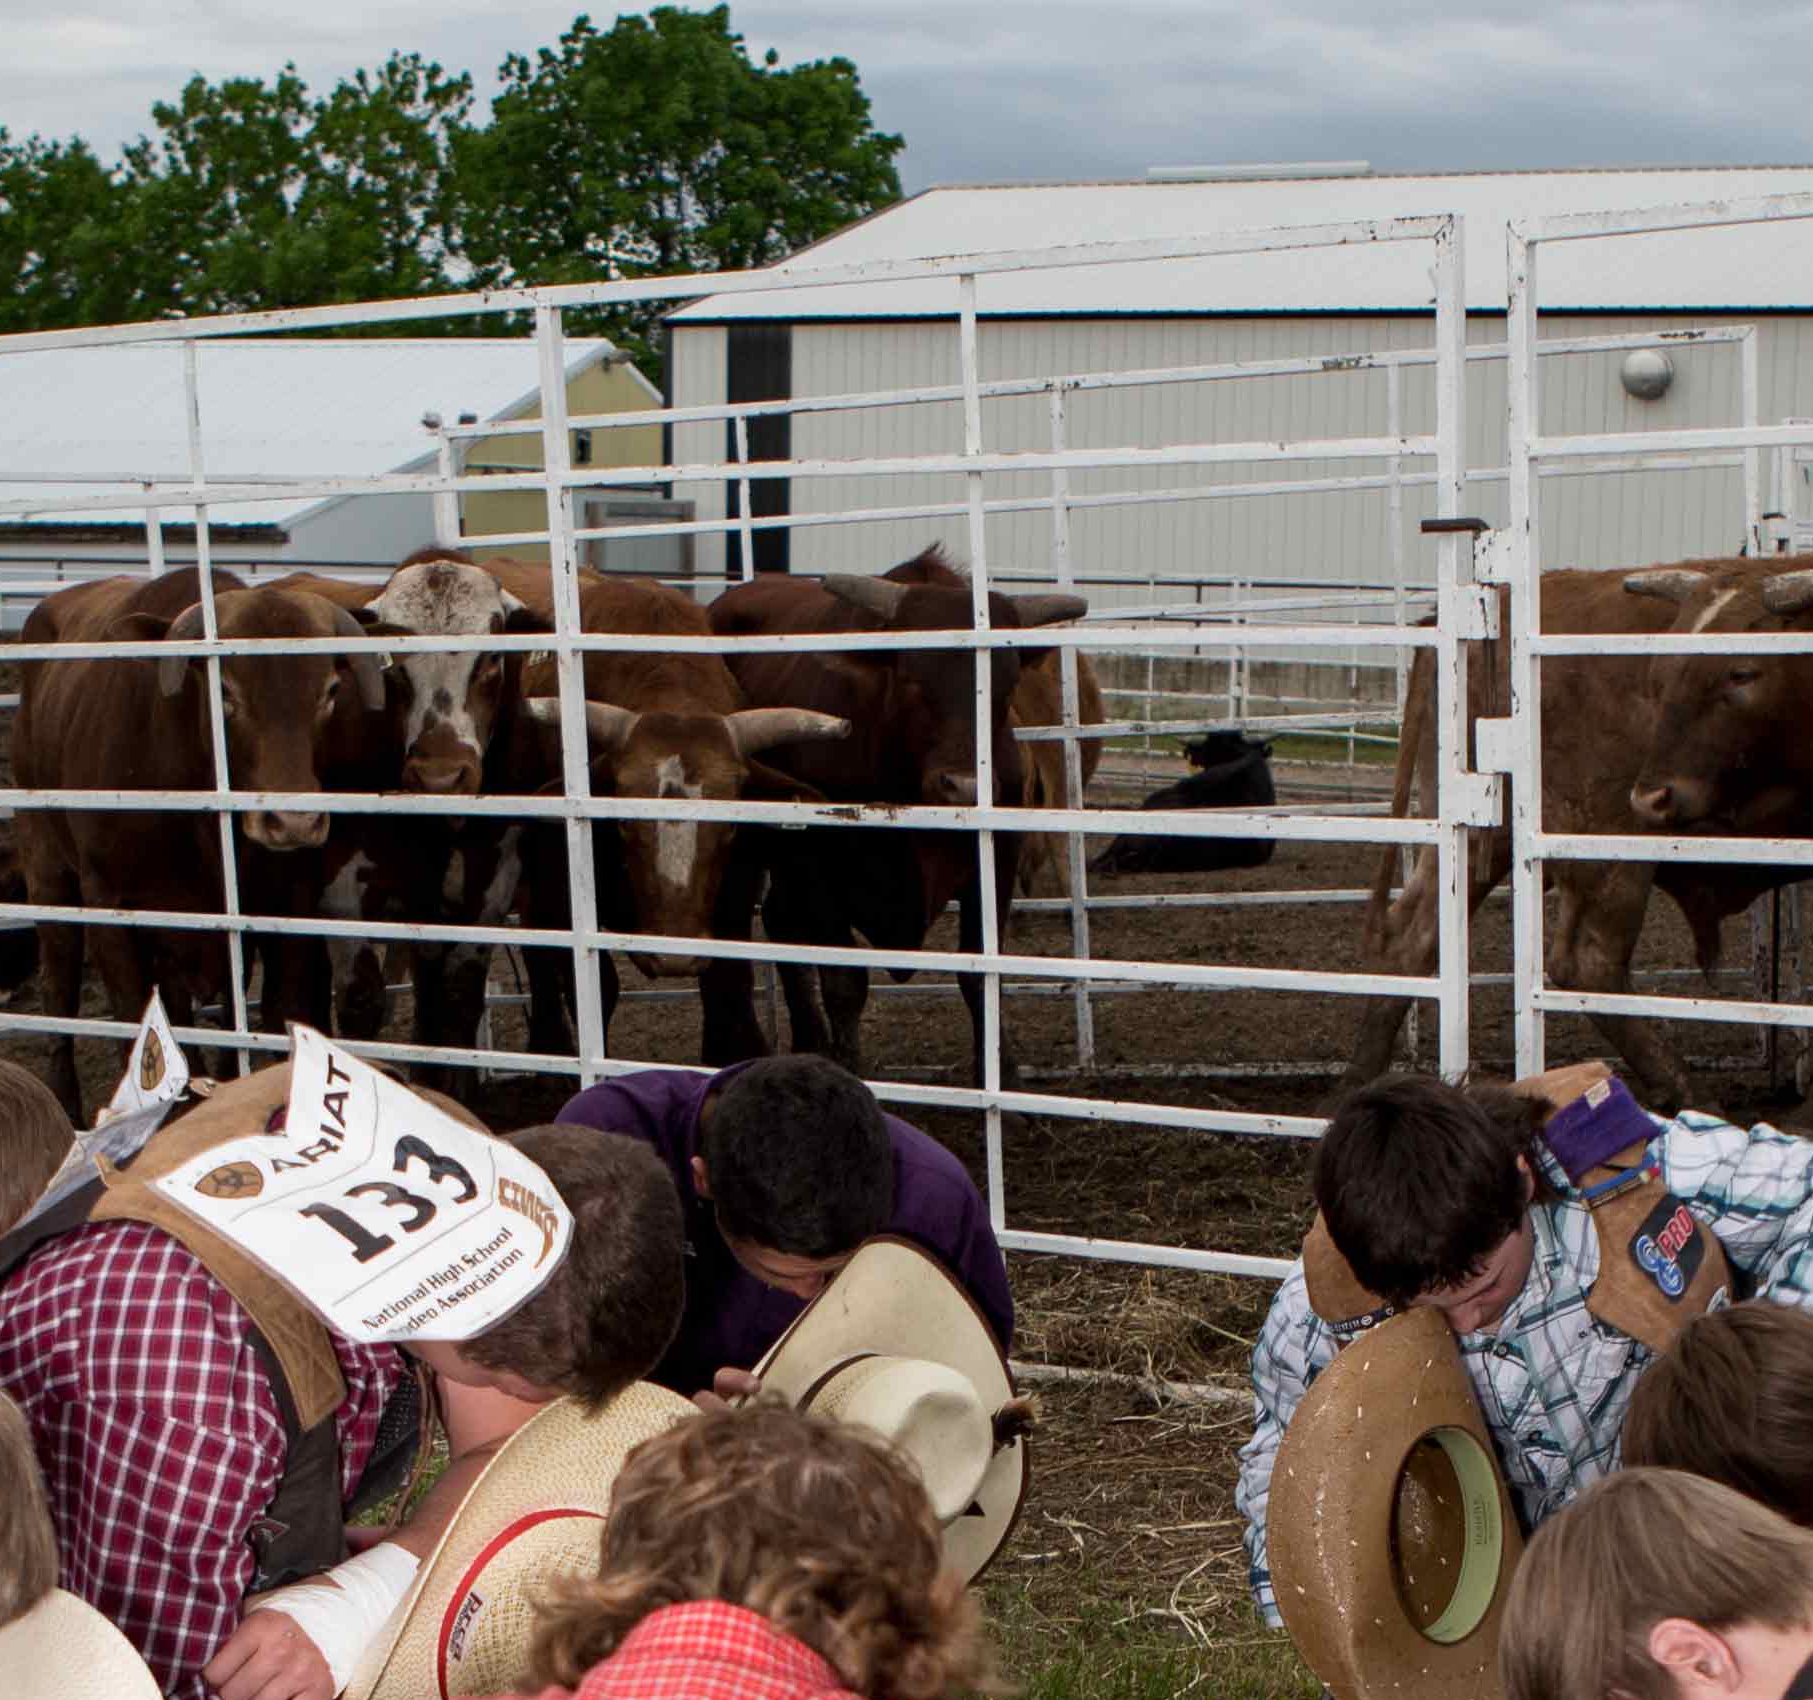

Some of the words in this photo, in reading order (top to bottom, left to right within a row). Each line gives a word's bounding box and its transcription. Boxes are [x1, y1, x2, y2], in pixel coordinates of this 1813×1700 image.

[271, 1053, 353, 1176] ARIAT
[298, 1133, 479, 1265] 133
[362, 1282, 431, 1329] National
[426, 1262, 465, 1291] High
[460, 1226, 514, 1269] School
[436, 1248, 524, 1313] Association
